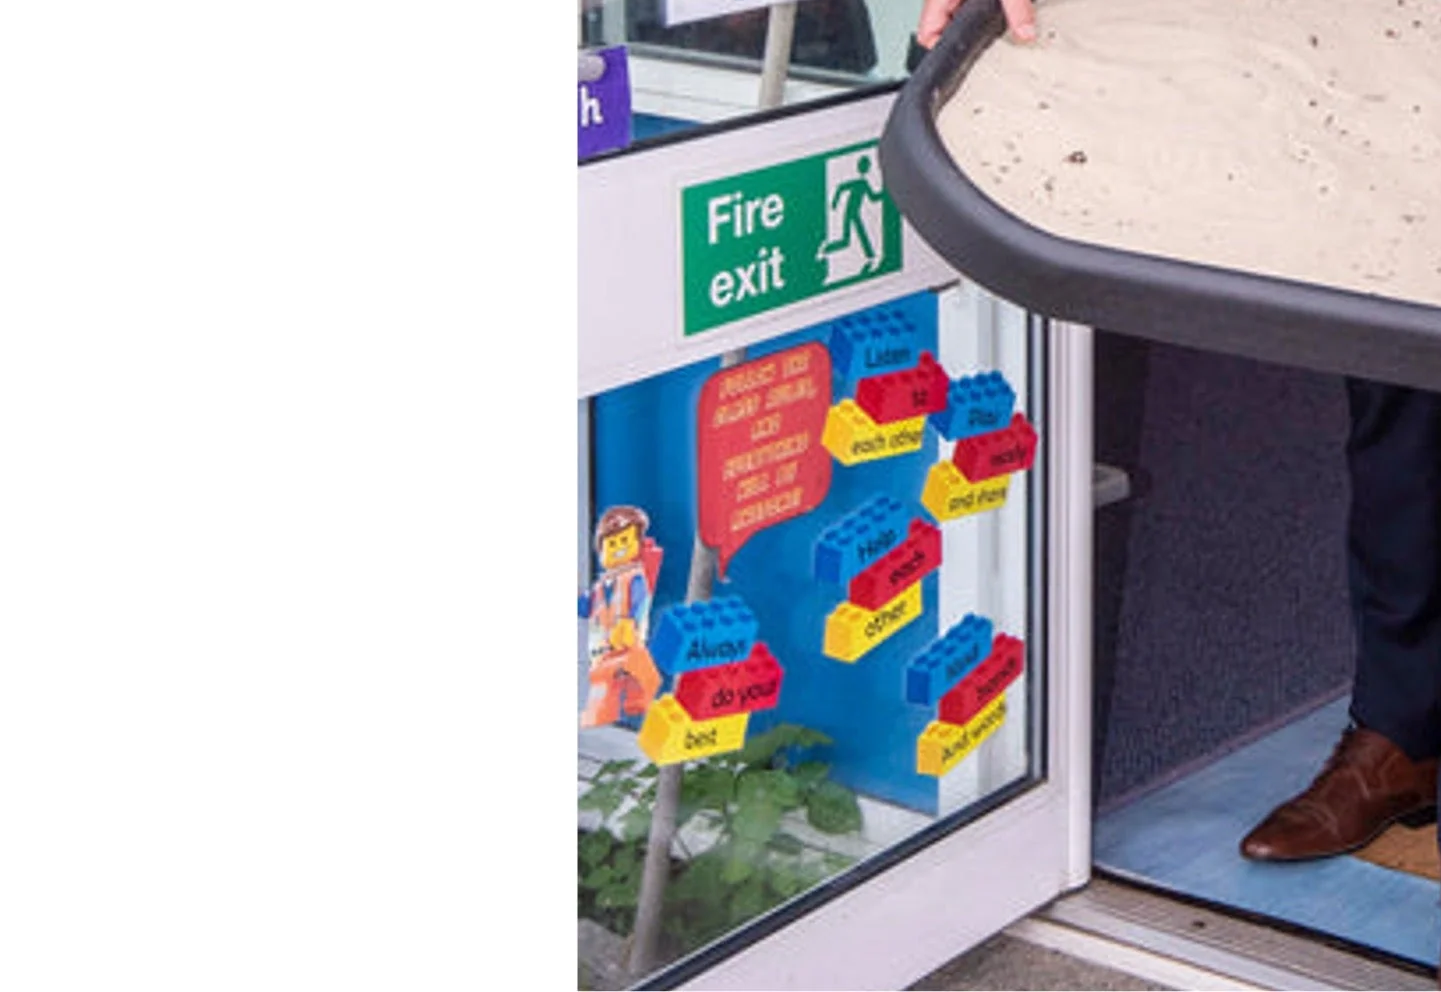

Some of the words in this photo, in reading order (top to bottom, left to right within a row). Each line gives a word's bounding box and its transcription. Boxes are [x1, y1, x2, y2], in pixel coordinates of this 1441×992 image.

[708, 191, 784, 244] Fire
[709, 246, 785, 307] exit
[863, 600, 907, 639] other
[688, 637, 746, 661] Always
[711, 686, 735, 708] do
[740, 678, 778, 705] your
[684, 728, 719, 750] best
